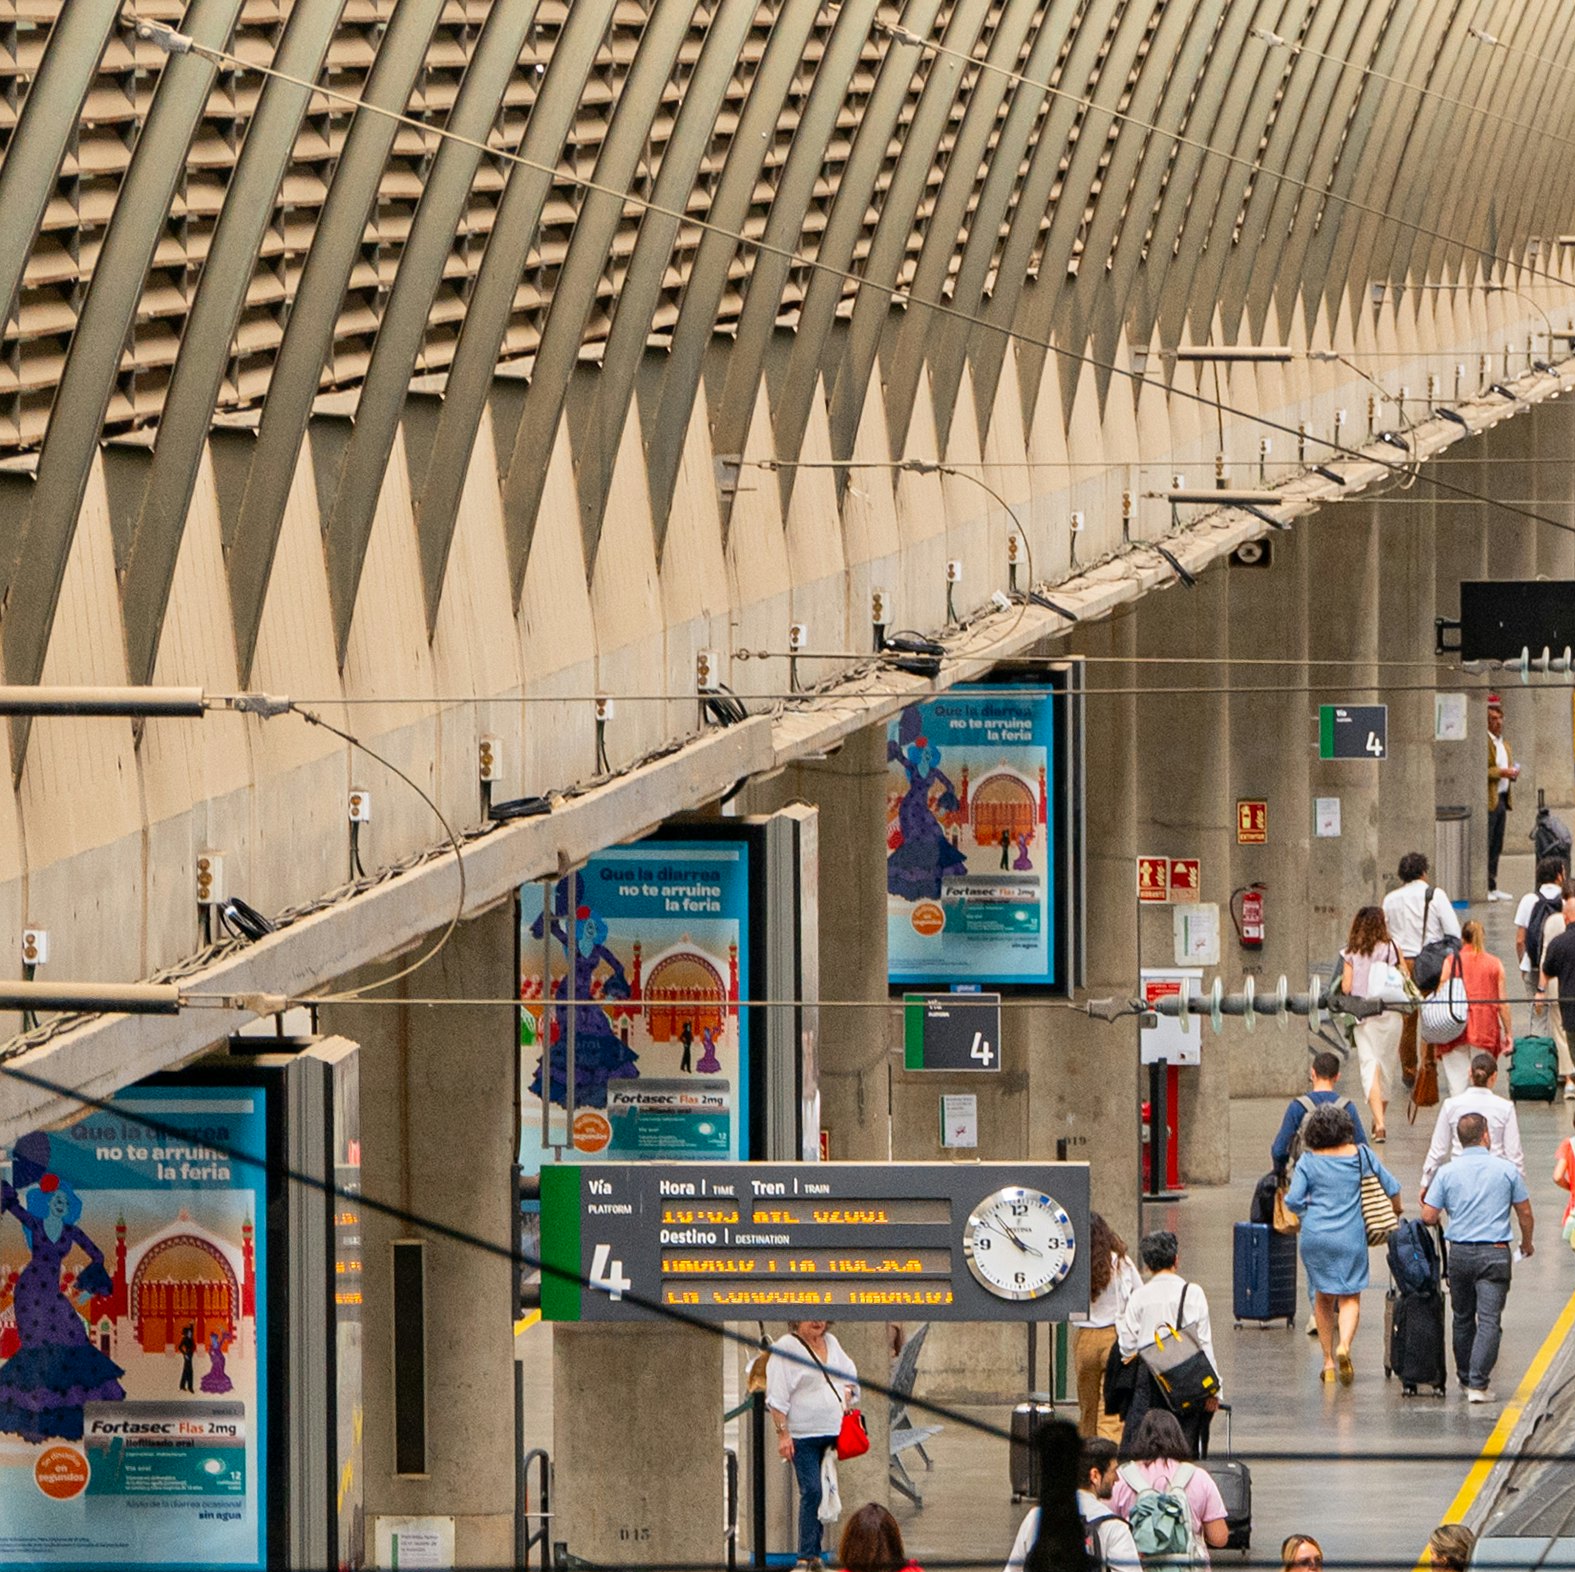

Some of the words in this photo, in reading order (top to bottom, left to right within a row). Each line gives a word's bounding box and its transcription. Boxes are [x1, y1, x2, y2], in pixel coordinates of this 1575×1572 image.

[950, 719, 966, 729] no
[969, 718, 982, 729] te
[984, 717, 1032, 729] arruine
[987, 730, 999, 740] la
[1001, 730, 1032, 740] feria
[1366, 732, 1383, 756] 4
[600, 868, 635, 881] Que
[638, 867, 653, 881] la
[657, 867, 720, 881] diarrea
[619, 885, 639, 896] no
[642, 884, 658, 896] te
[661, 882, 721, 896] arruine
[665, 898, 680, 911] la
[682, 898, 720, 911] feria
[970, 1032, 994, 1066] 4
[613, 1093, 674, 1104] Fortasec
[679, 1093, 699, 1104] Flas
[701, 1095, 724, 1107] 2mg
[71, 1124, 116, 1140] Que
[96, 1145, 123, 1161] no
[126, 1144, 148, 1161] te
[157, 1163, 177, 1180] la
[181, 1163, 231, 1180] feria
[588, 1179, 613, 1195] Vía
[660, 1180, 695, 1195] Hora
[712, 1184, 735, 1196] TIME
[751, 1180, 785, 1195] Tren
[804, 1183, 830, 1194] TRAIN
[588, 1203, 632, 1215] PLATFORM
[1011, 1204, 1029, 1217] 12
[660, 1229, 717, 1244] Destino
[735, 1233, 790, 1245] DESTINATION
[1048, 1238, 1059, 1250] 3
[980, 1239, 991, 1250] 9
[589, 1244, 631, 1301] 4
[1014, 1272, 1026, 1284] 6
[91, 1420, 172, 1434] Fortasec
[179, 1421, 204, 1434] Flas
[208, 1422, 237, 1436] 2mg
[230, 1471, 242, 1480] 12
